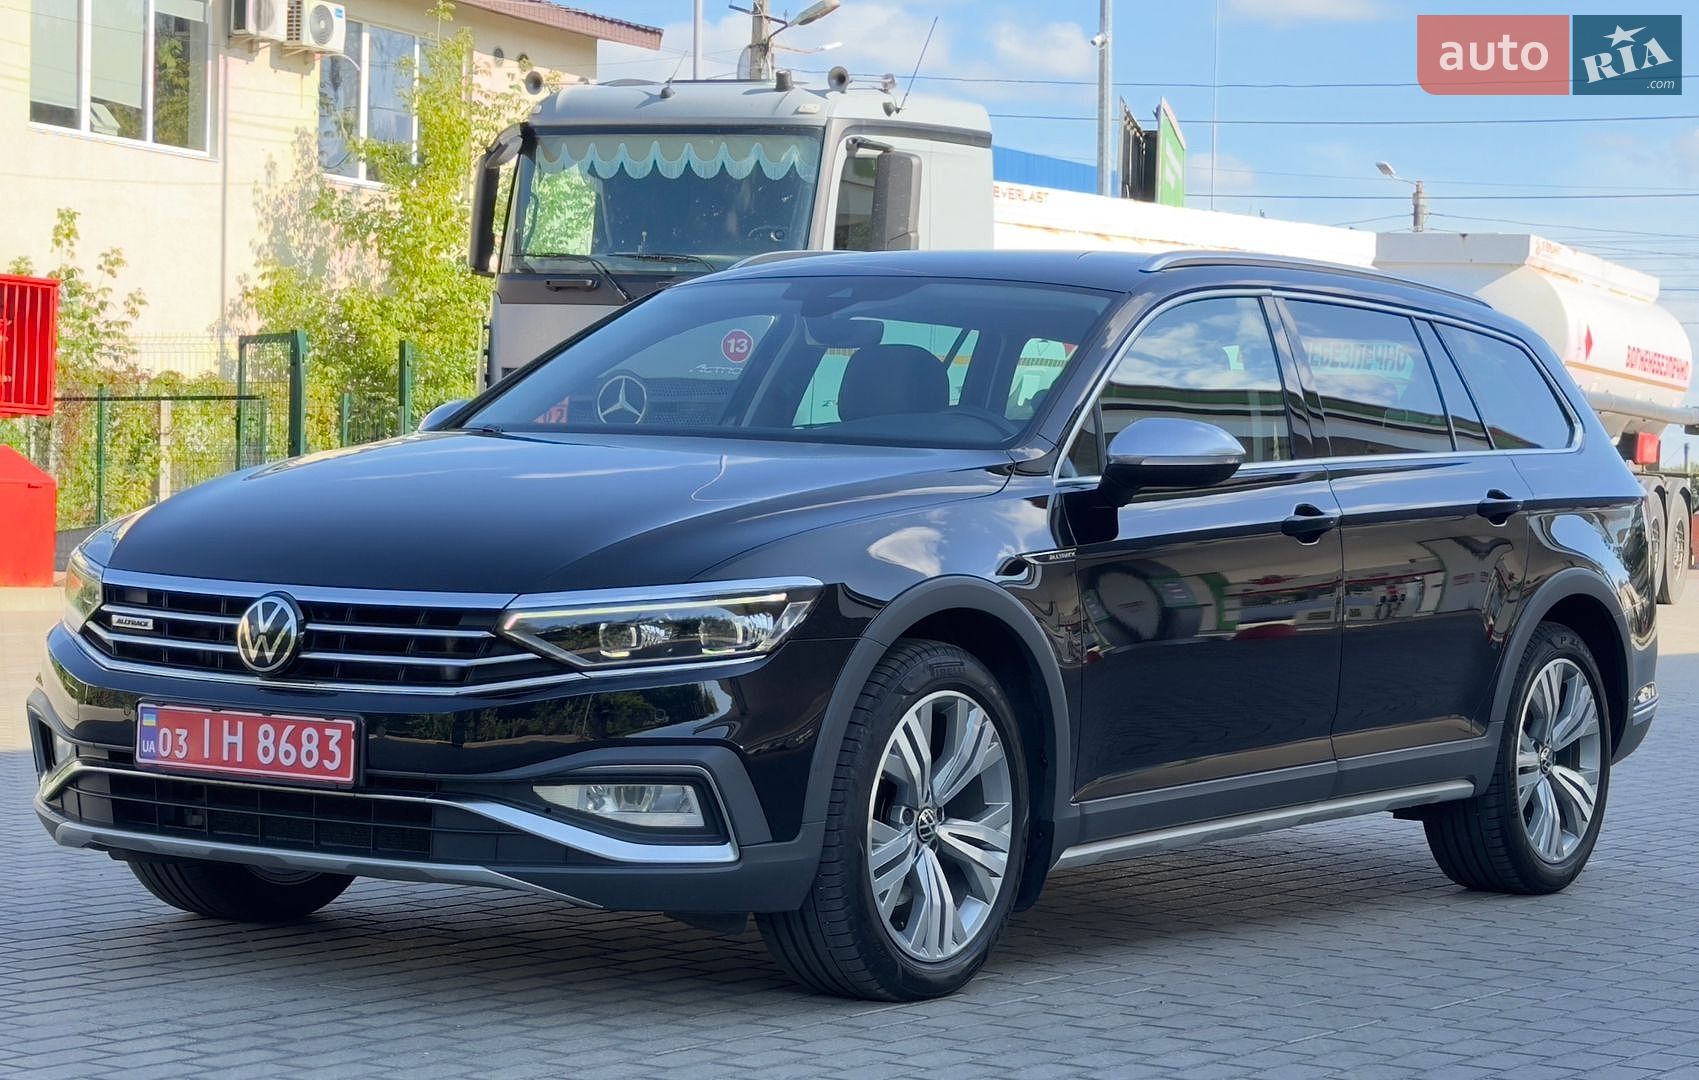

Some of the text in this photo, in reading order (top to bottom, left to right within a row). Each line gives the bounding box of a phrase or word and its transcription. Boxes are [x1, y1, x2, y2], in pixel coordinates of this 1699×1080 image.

[728, 338, 749, 354] 13
[142, 740, 155, 753] UA
[158, 727, 188, 759] 03
[256, 723, 342, 771] 8683
